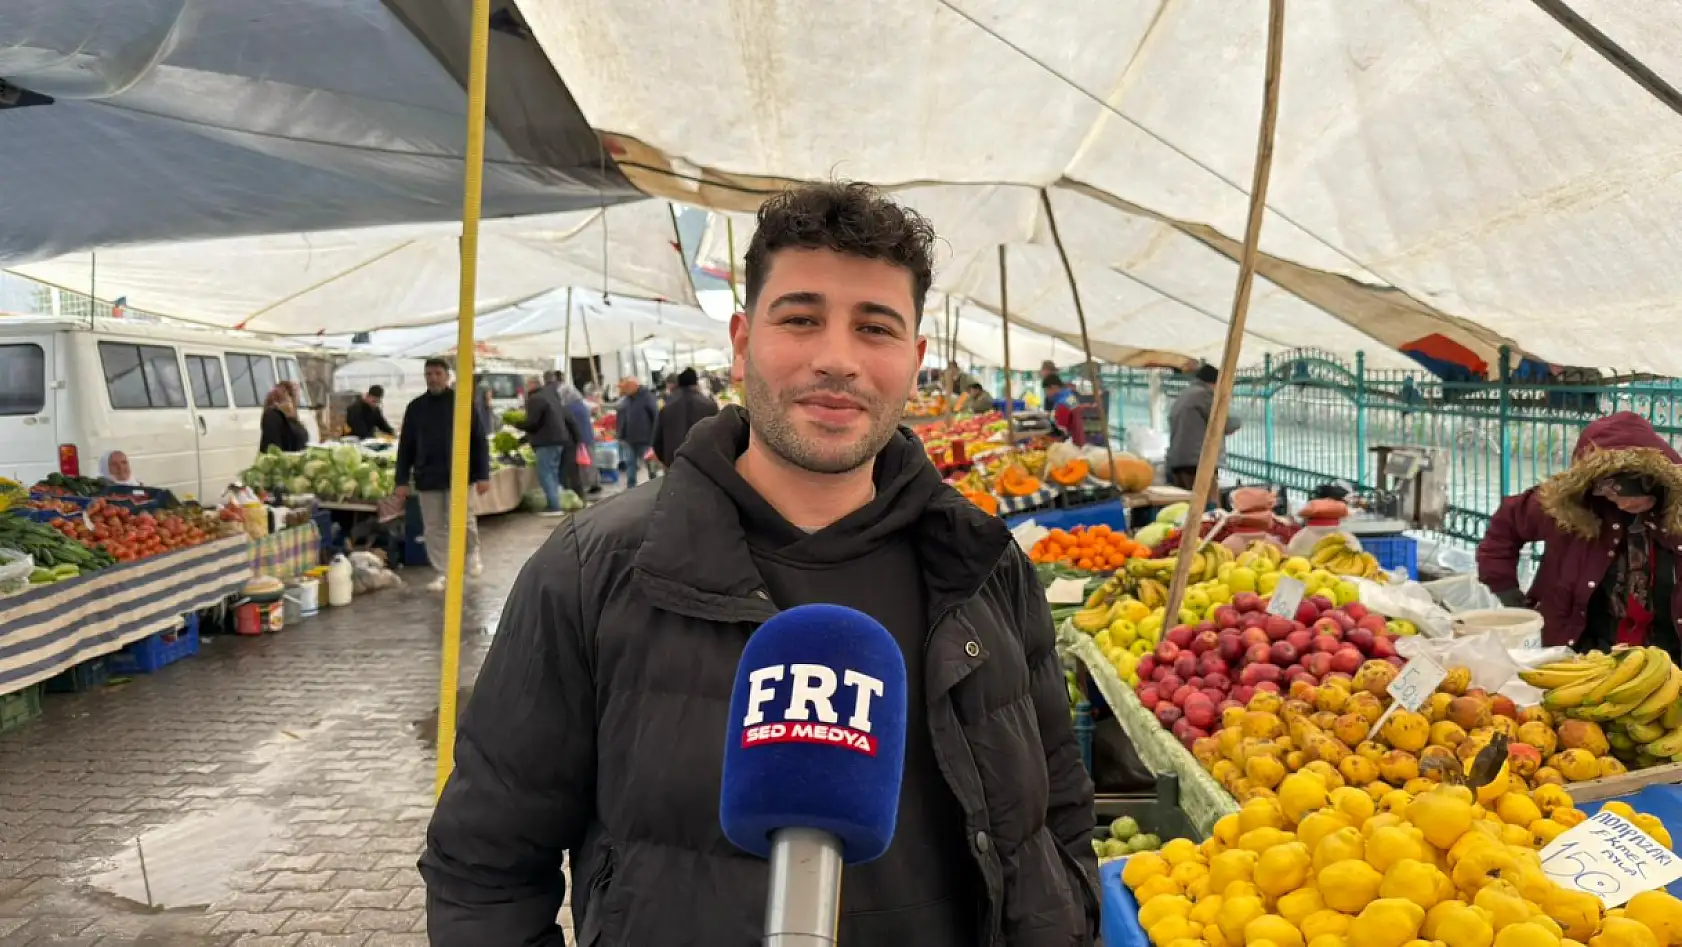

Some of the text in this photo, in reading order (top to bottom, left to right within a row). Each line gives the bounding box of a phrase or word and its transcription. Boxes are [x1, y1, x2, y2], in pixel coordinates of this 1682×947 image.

[743, 664, 884, 733] FRT
[746, 724, 871, 752] SED MEDYA
